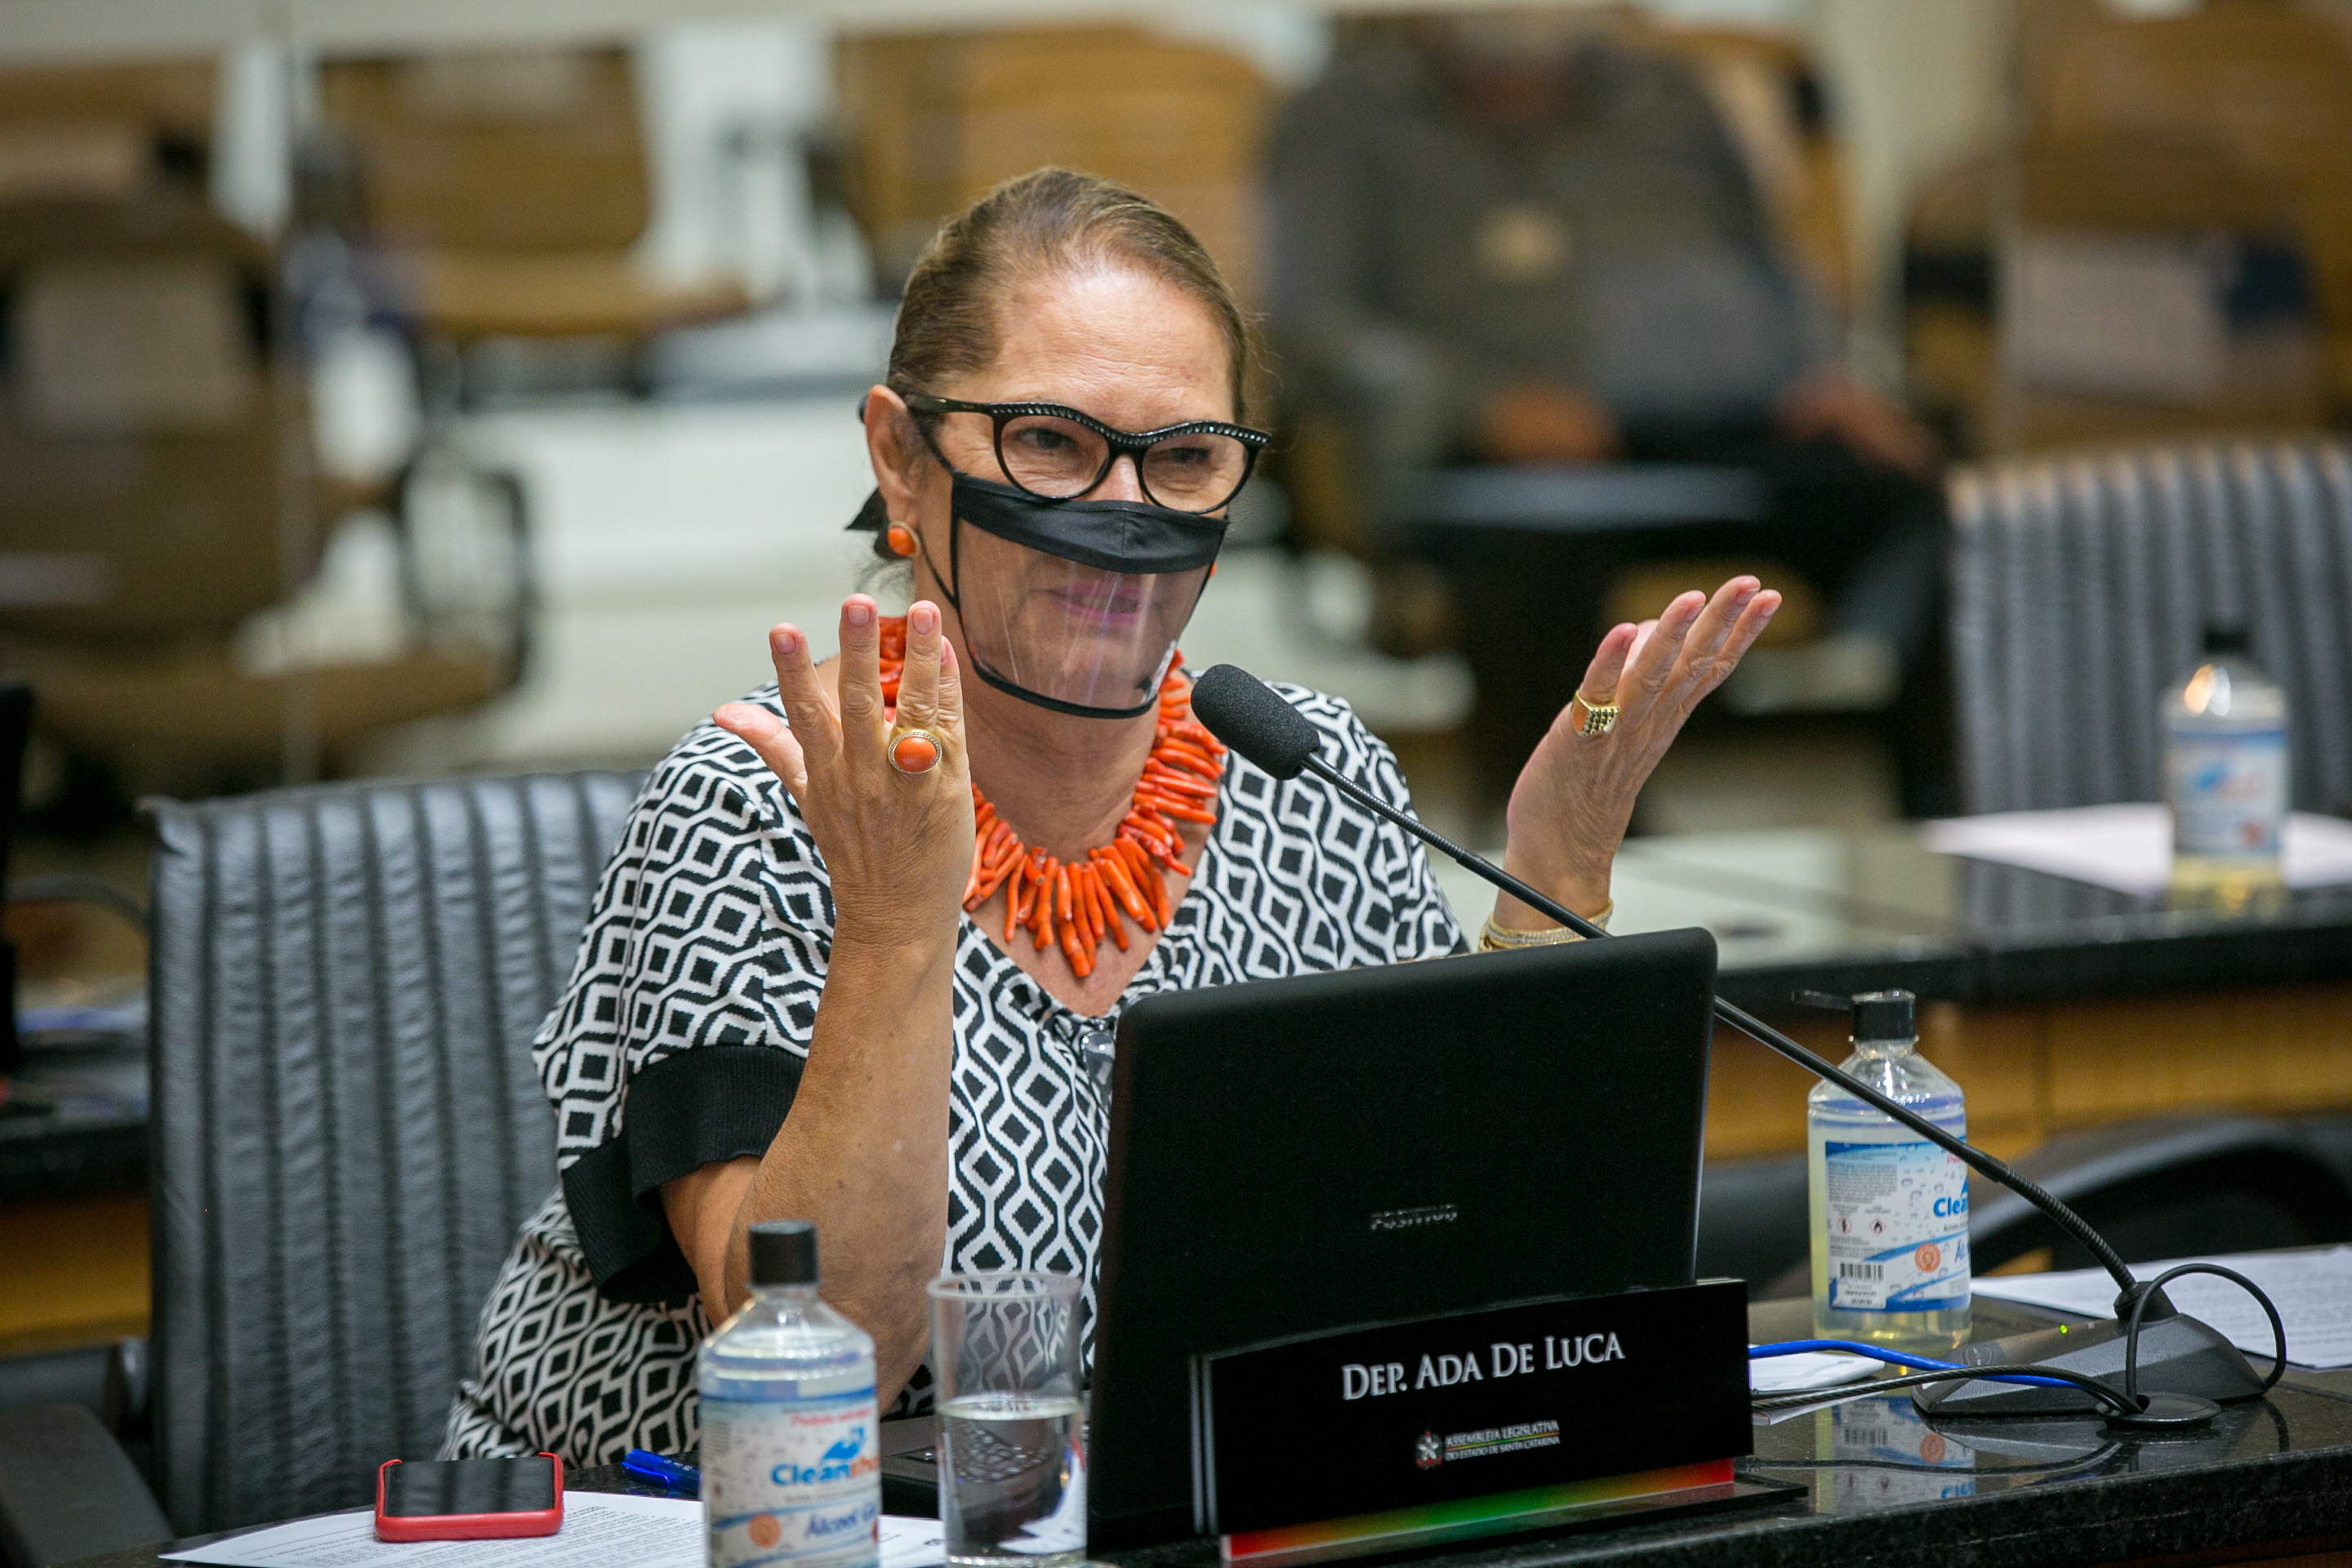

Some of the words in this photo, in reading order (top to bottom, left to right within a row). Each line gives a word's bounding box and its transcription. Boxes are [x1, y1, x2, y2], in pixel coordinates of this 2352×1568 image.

[1446, 1428, 1501, 1447] ASSEMBLEIA
[1501, 1420, 1559, 1439] LEGISLATIVA
[1446, 1451, 1459, 1461] DO
[1459, 1446, 1488, 1459] ESTADO
[1489, 1445, 1499, 1454] DE
[1499, 1441, 1523, 1454] SANTA
[1523, 1437, 1560, 1450] CATARINA
